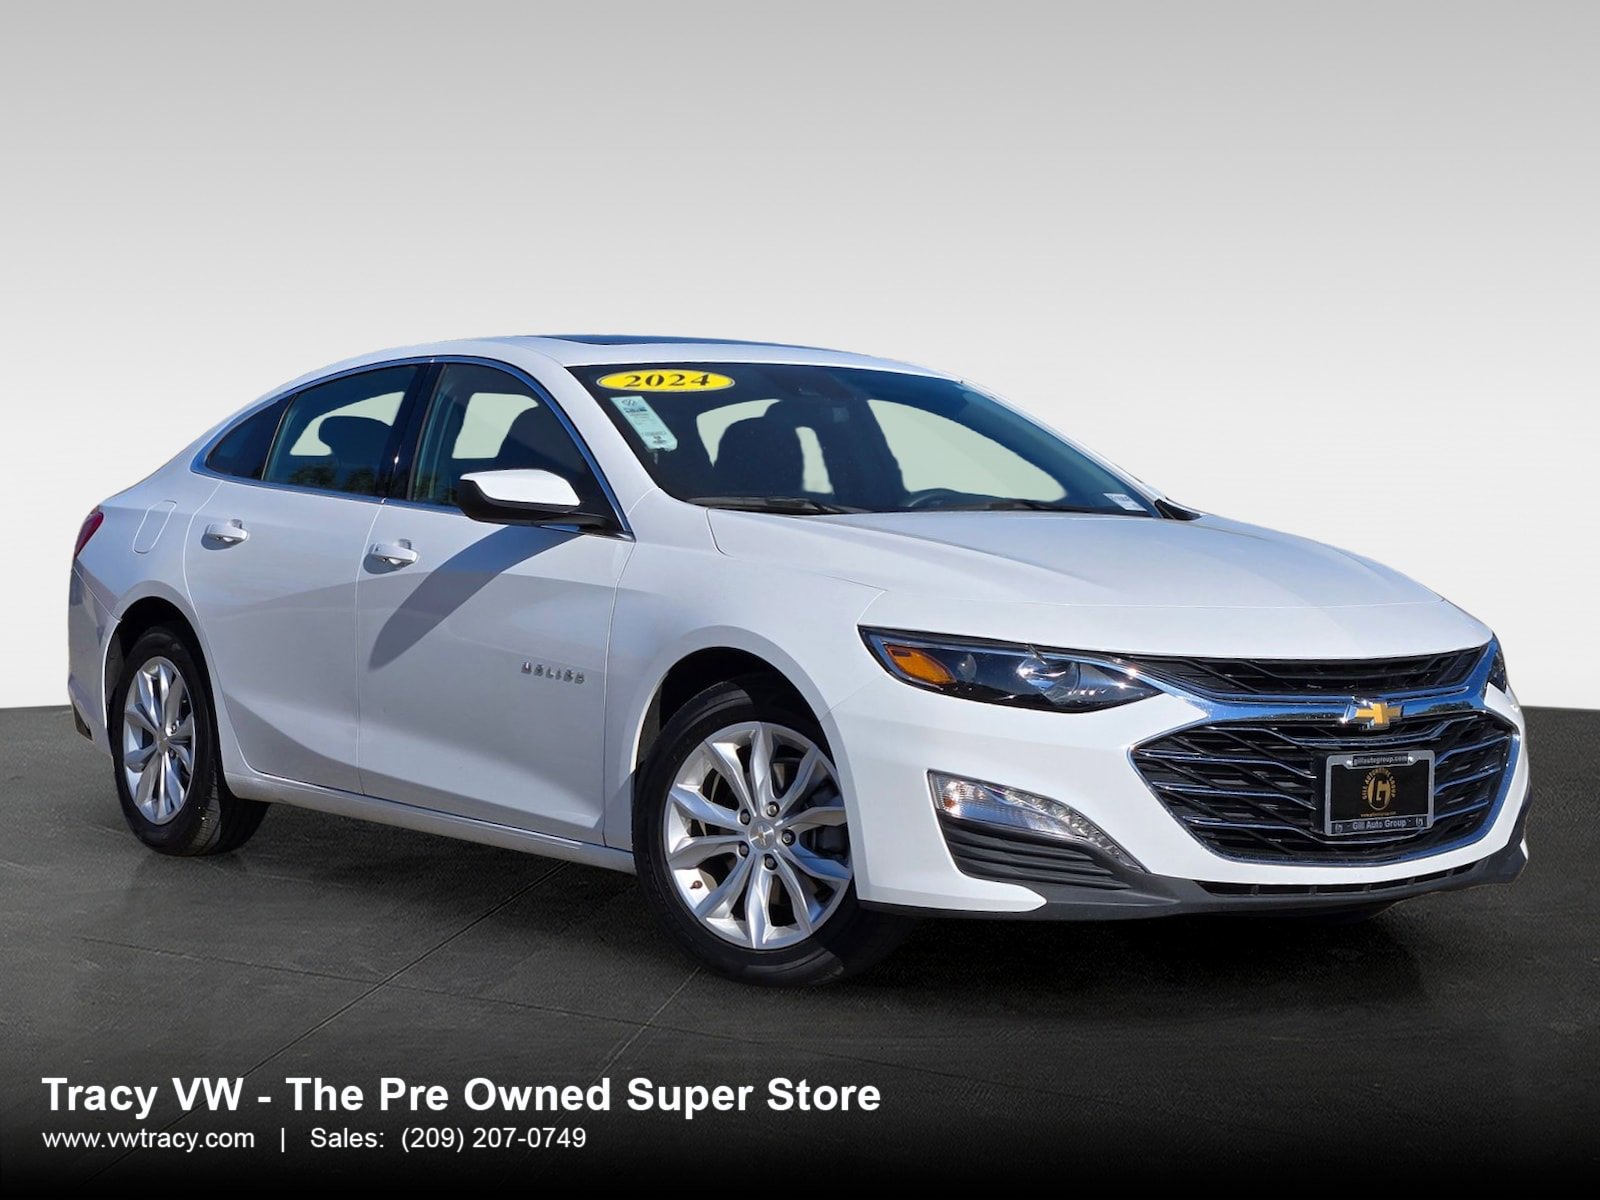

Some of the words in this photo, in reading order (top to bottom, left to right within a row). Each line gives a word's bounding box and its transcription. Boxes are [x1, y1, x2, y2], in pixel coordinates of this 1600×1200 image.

[624, 373, 710, 388] 2024
[520, 660, 585, 685] MALIBU
[1352, 821, 1365, 830] Gill
[1366, 820, 1383, 829] Auto
[1384, 819, 1407, 829] Group
